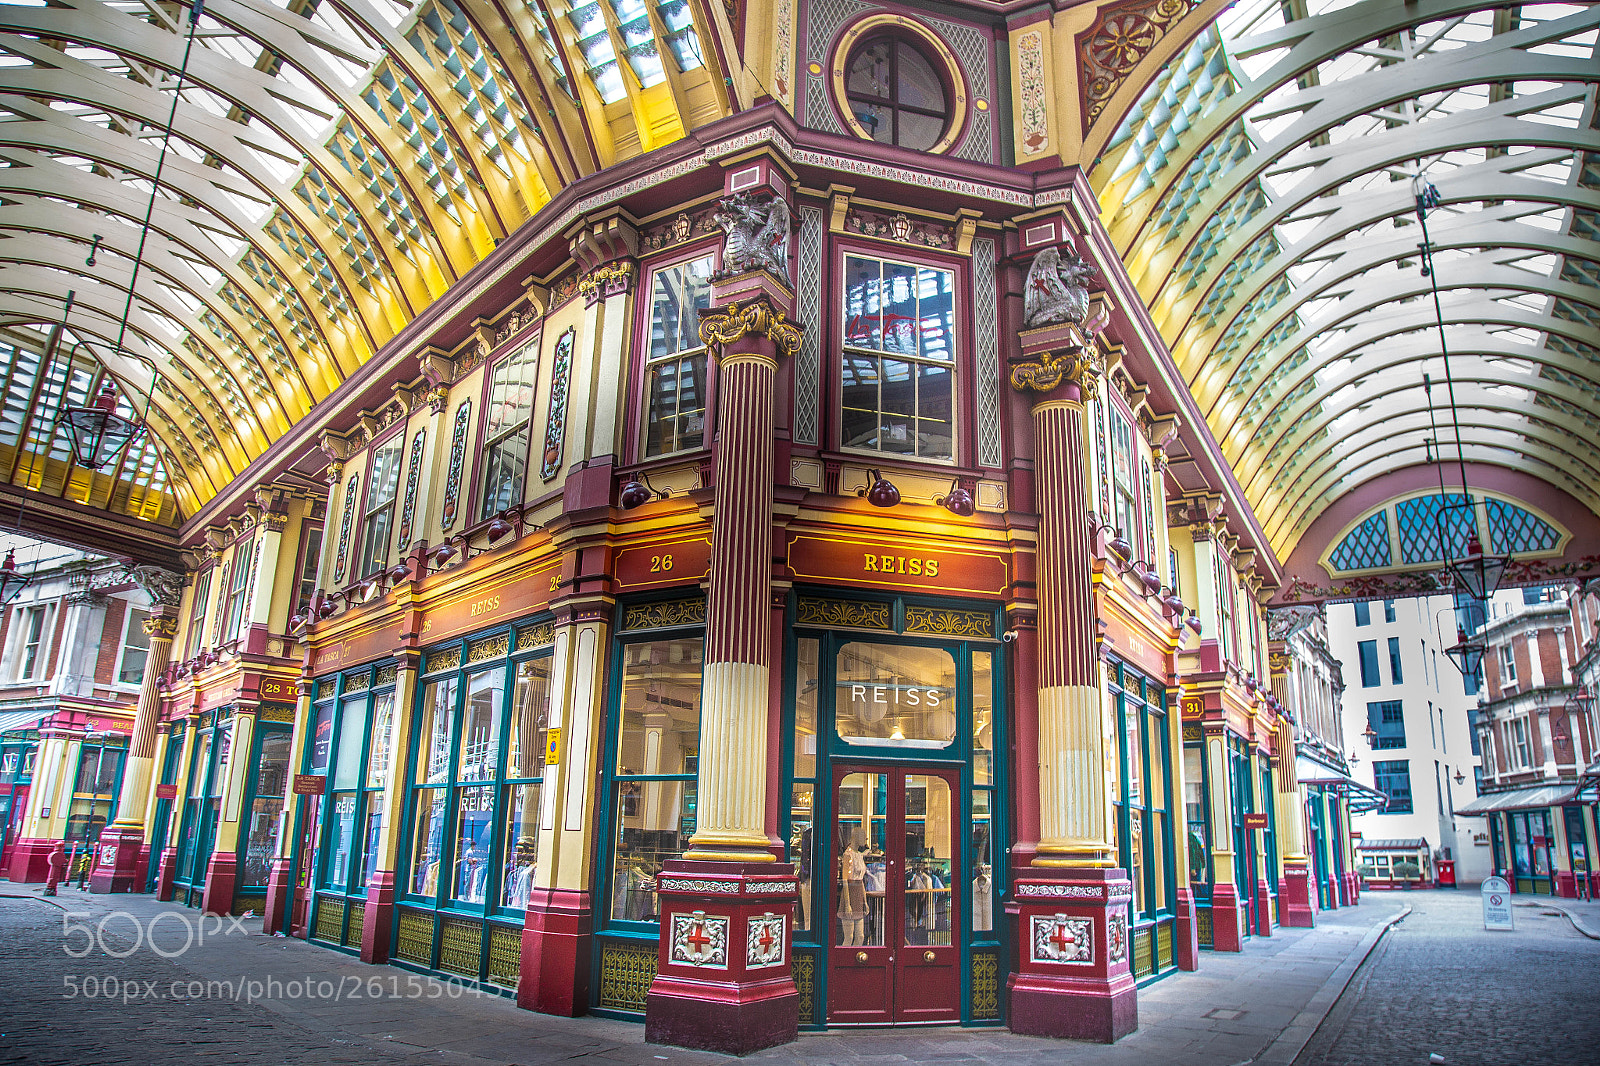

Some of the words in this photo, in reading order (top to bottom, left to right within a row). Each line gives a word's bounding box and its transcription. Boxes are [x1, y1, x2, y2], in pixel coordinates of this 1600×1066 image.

[651, 555, 673, 573] 26
[864, 553, 940, 577] REISS
[470, 595, 501, 617] REISS
[422, 619, 432, 633] 26
[265, 683, 281, 694] 28
[852, 684, 940, 707] REISS
[1186, 702, 1200, 713] 31
